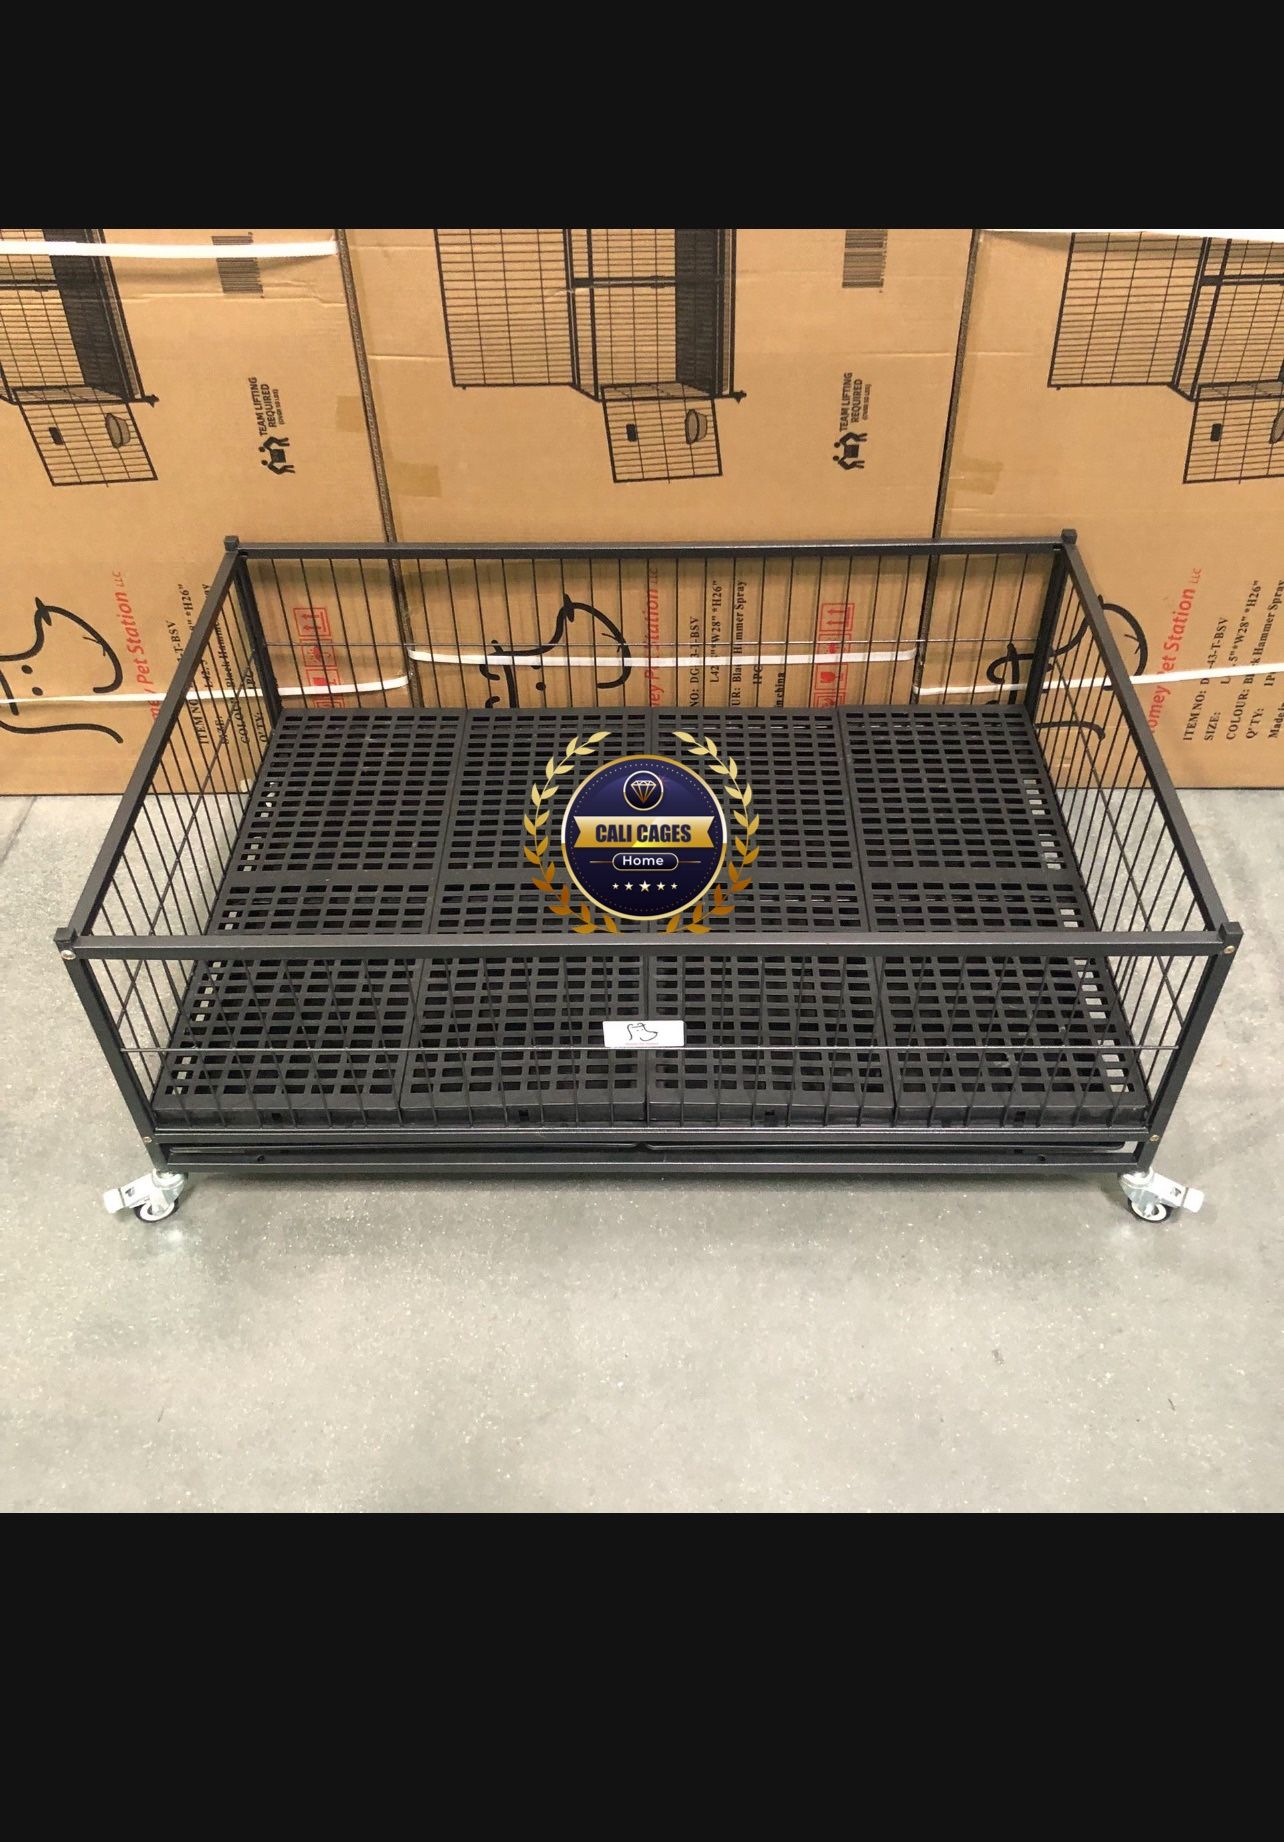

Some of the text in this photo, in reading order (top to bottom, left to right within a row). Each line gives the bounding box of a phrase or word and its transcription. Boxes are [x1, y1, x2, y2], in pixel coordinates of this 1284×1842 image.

[248, 376, 267, 436] TEAM LIFTING
[260, 383, 277, 427] REQUIRED
[839, 372, 853, 432] TEAM LIFTING
[850, 378, 862, 423] REQUIRED
[112, 571, 126, 588] LLC
[735, 580, 747, 611] Spray
[114, 591, 144, 655] Station
[214, 620, 229, 659] Hamme
[733, 612, 744, 655] Hmmer
[134, 658, 153, 685] Pet
[690, 616, 700, 683] DG-3-T-BSV
[710, 616, 721, 683] L42"W28"
[1147, 567, 1202, 733] omey et Station LLC
[1226, 579, 1284, 741] COLOUR: Blk Hammer Spray
[1183, 616, 1229, 741] ITEM NO: D-43-T-BSV
[1204, 711, 1221, 742] SIZE:
[1220, 616, 1250, 685] L.5"W28"
[1264, 671, 1277, 687] 1P
[188, 699, 201, 713] NO
[229, 697, 250, 744] COLOU
[1267, 711, 1284, 739] Made
[193, 716, 210, 745] ITEM
